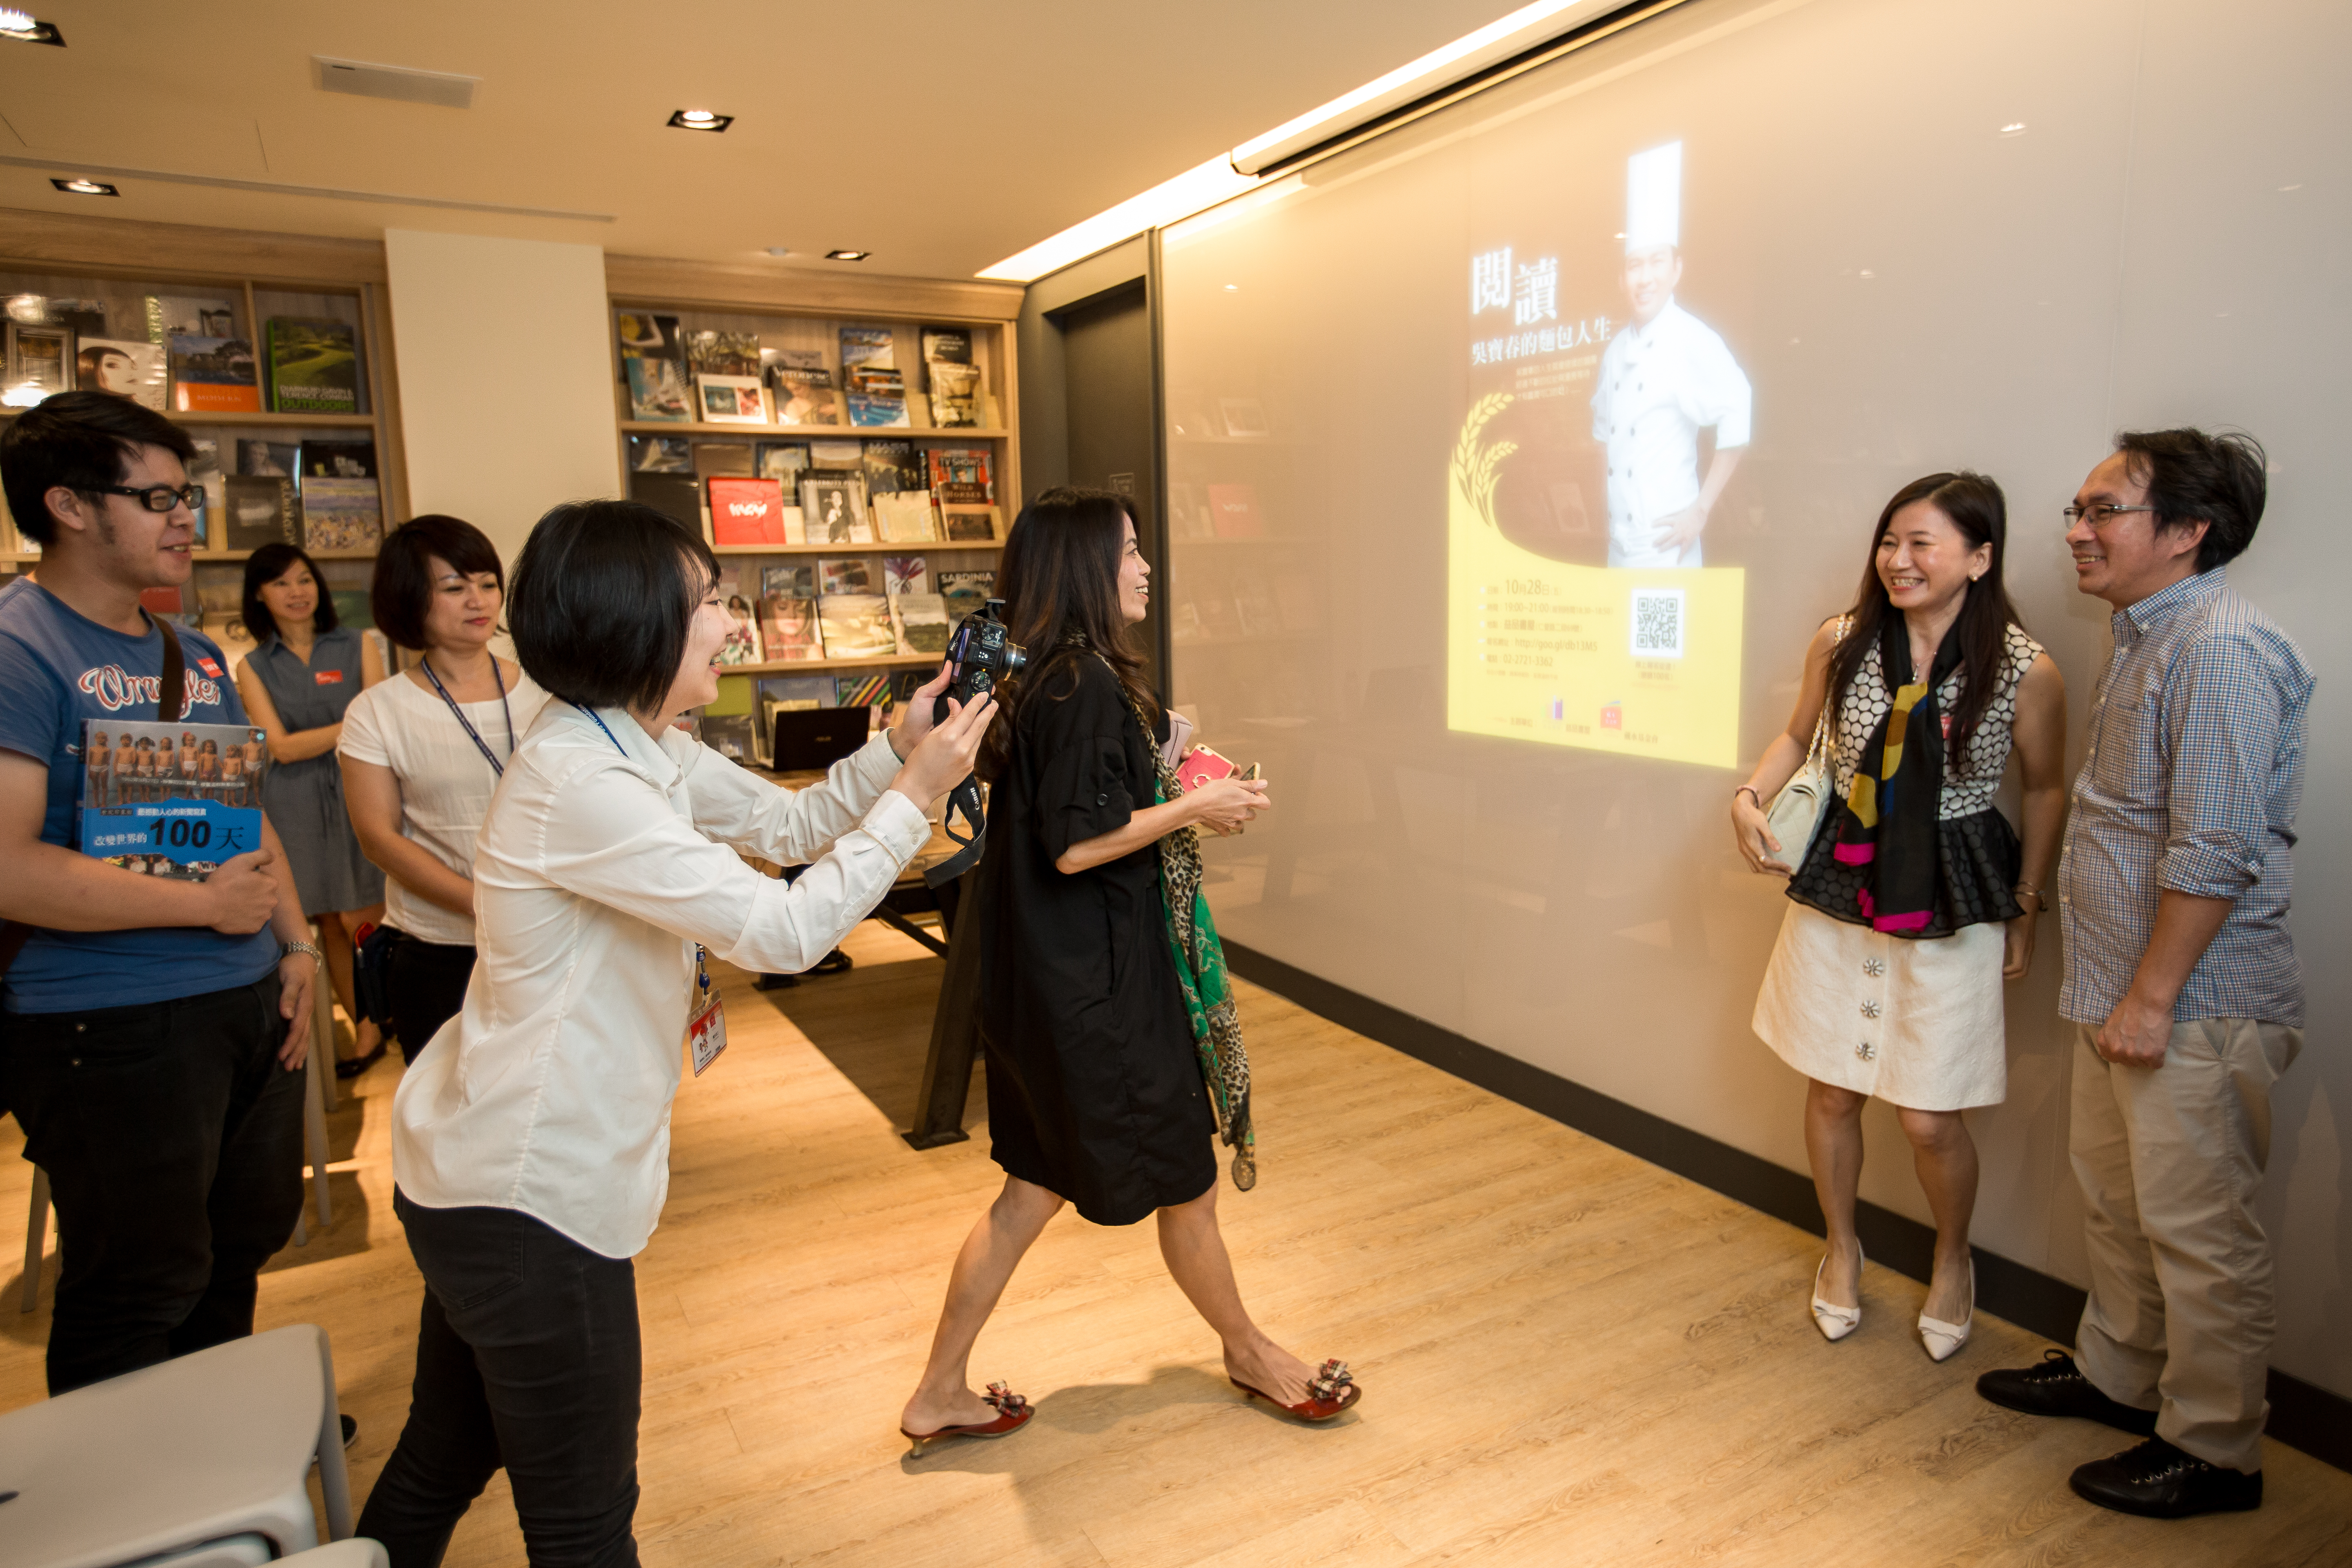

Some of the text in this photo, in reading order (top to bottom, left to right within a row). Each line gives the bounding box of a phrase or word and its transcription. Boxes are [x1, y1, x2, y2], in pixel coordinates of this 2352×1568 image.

[1472, 247, 1558, 326] 閱讀
[93, 817, 245, 851] 改變世界的 100 天
